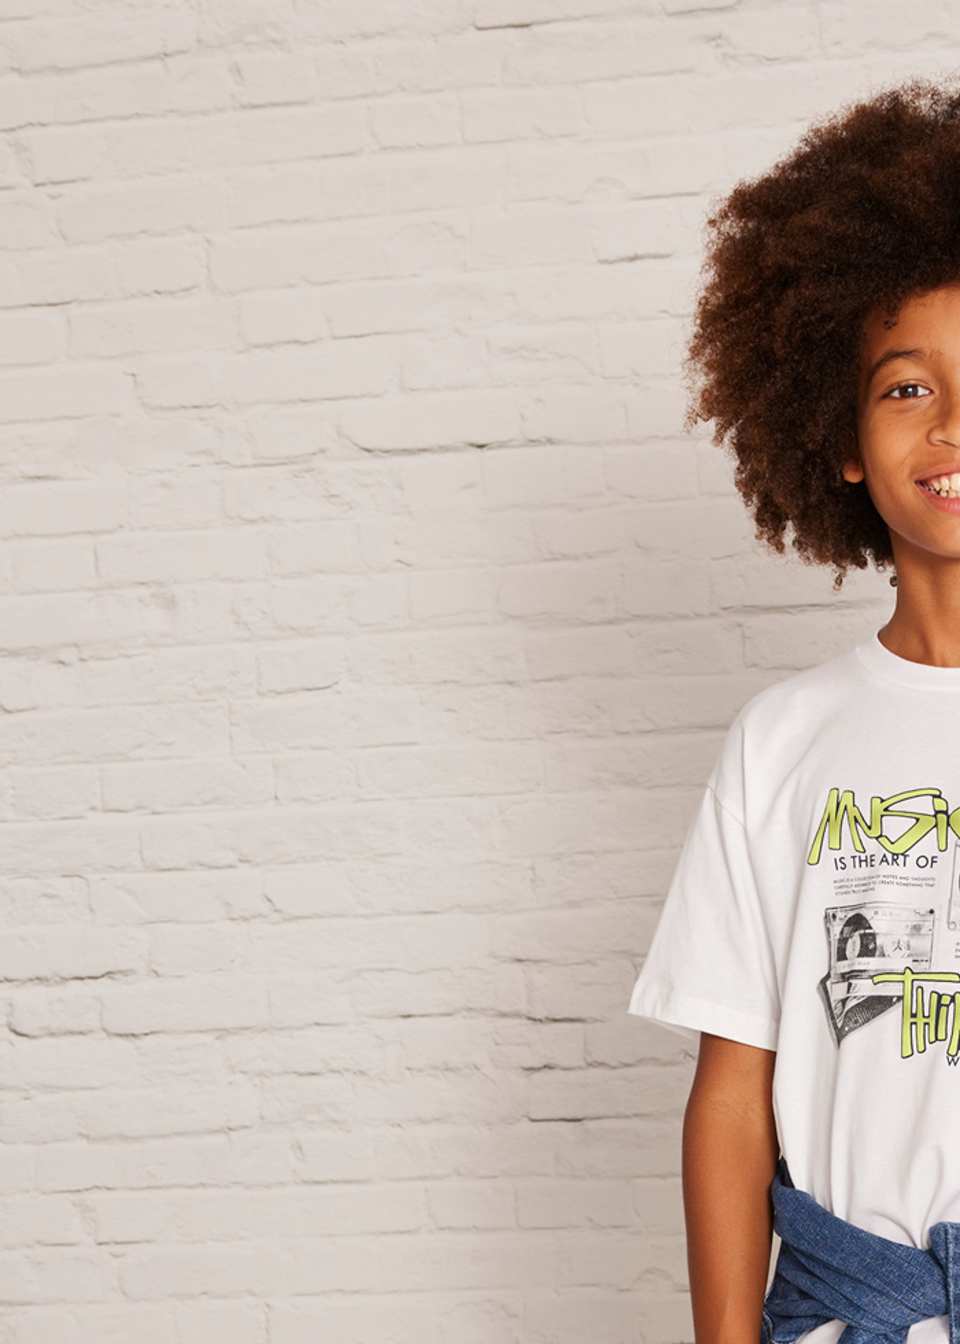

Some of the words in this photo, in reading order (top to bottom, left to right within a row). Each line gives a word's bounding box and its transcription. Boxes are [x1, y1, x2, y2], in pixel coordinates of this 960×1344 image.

[834, 856, 847, 871] IS
[851, 854, 876, 869] THE
[879, 853, 910, 868] ART
[915, 855, 939, 869] OF
